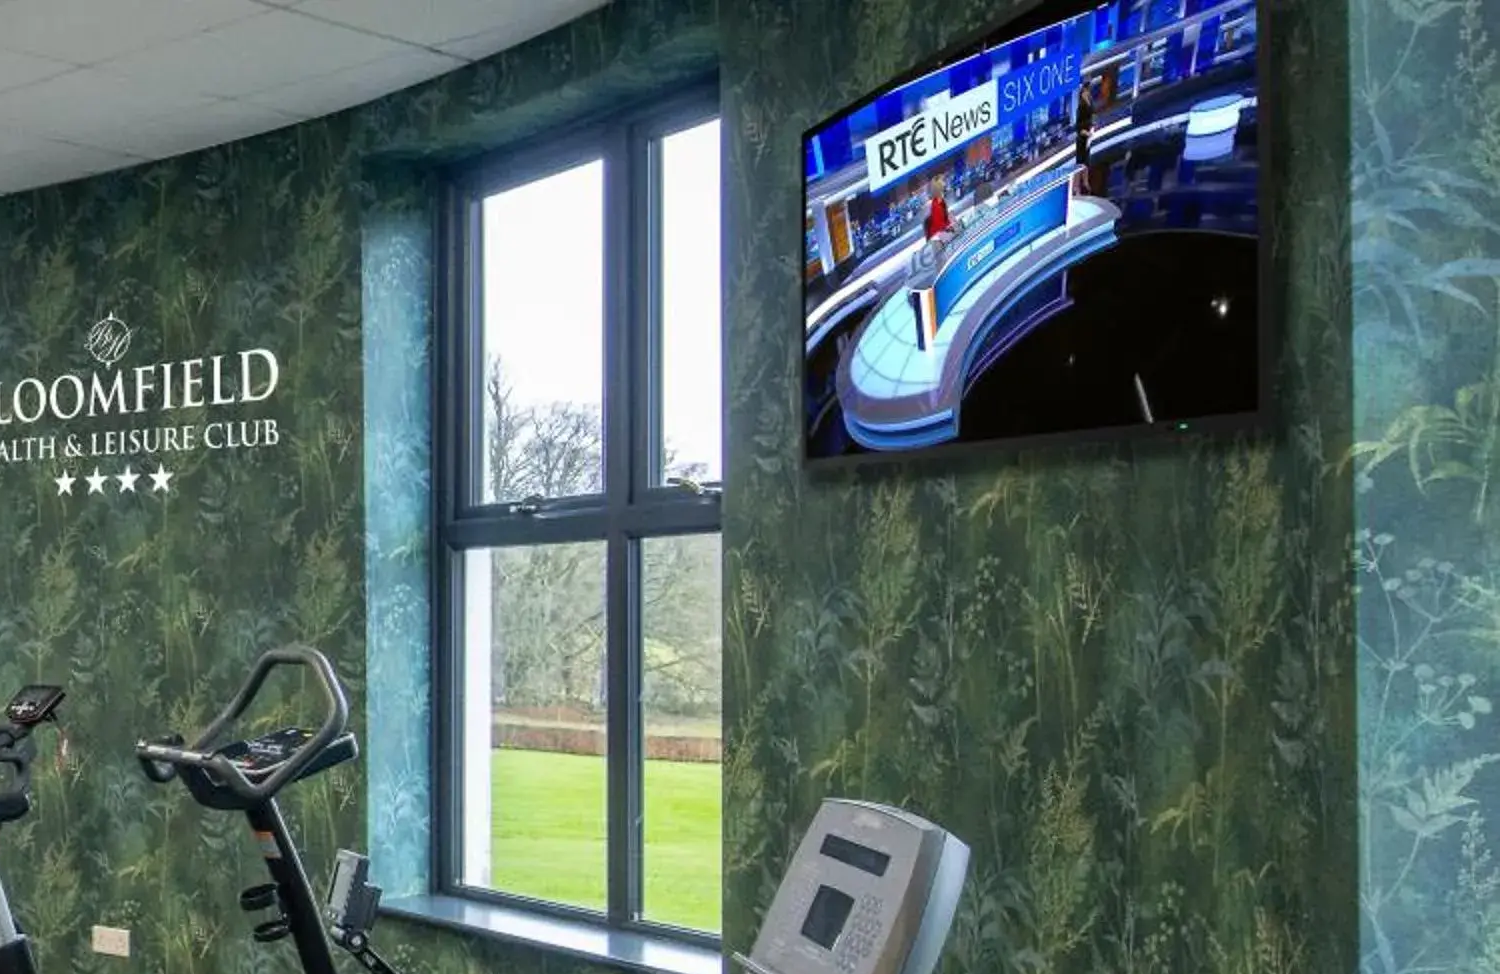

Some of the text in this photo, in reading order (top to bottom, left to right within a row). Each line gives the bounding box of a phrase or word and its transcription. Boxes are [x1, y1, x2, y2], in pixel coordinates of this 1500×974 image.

[931, 101, 992, 149] News
[1003, 71, 1036, 113] SIX
[1039, 54, 1075, 94] ONE
[64, 434, 83, 458] &
[90, 425, 196, 456] LEISURE
[203, 419, 280, 450] CLUB
